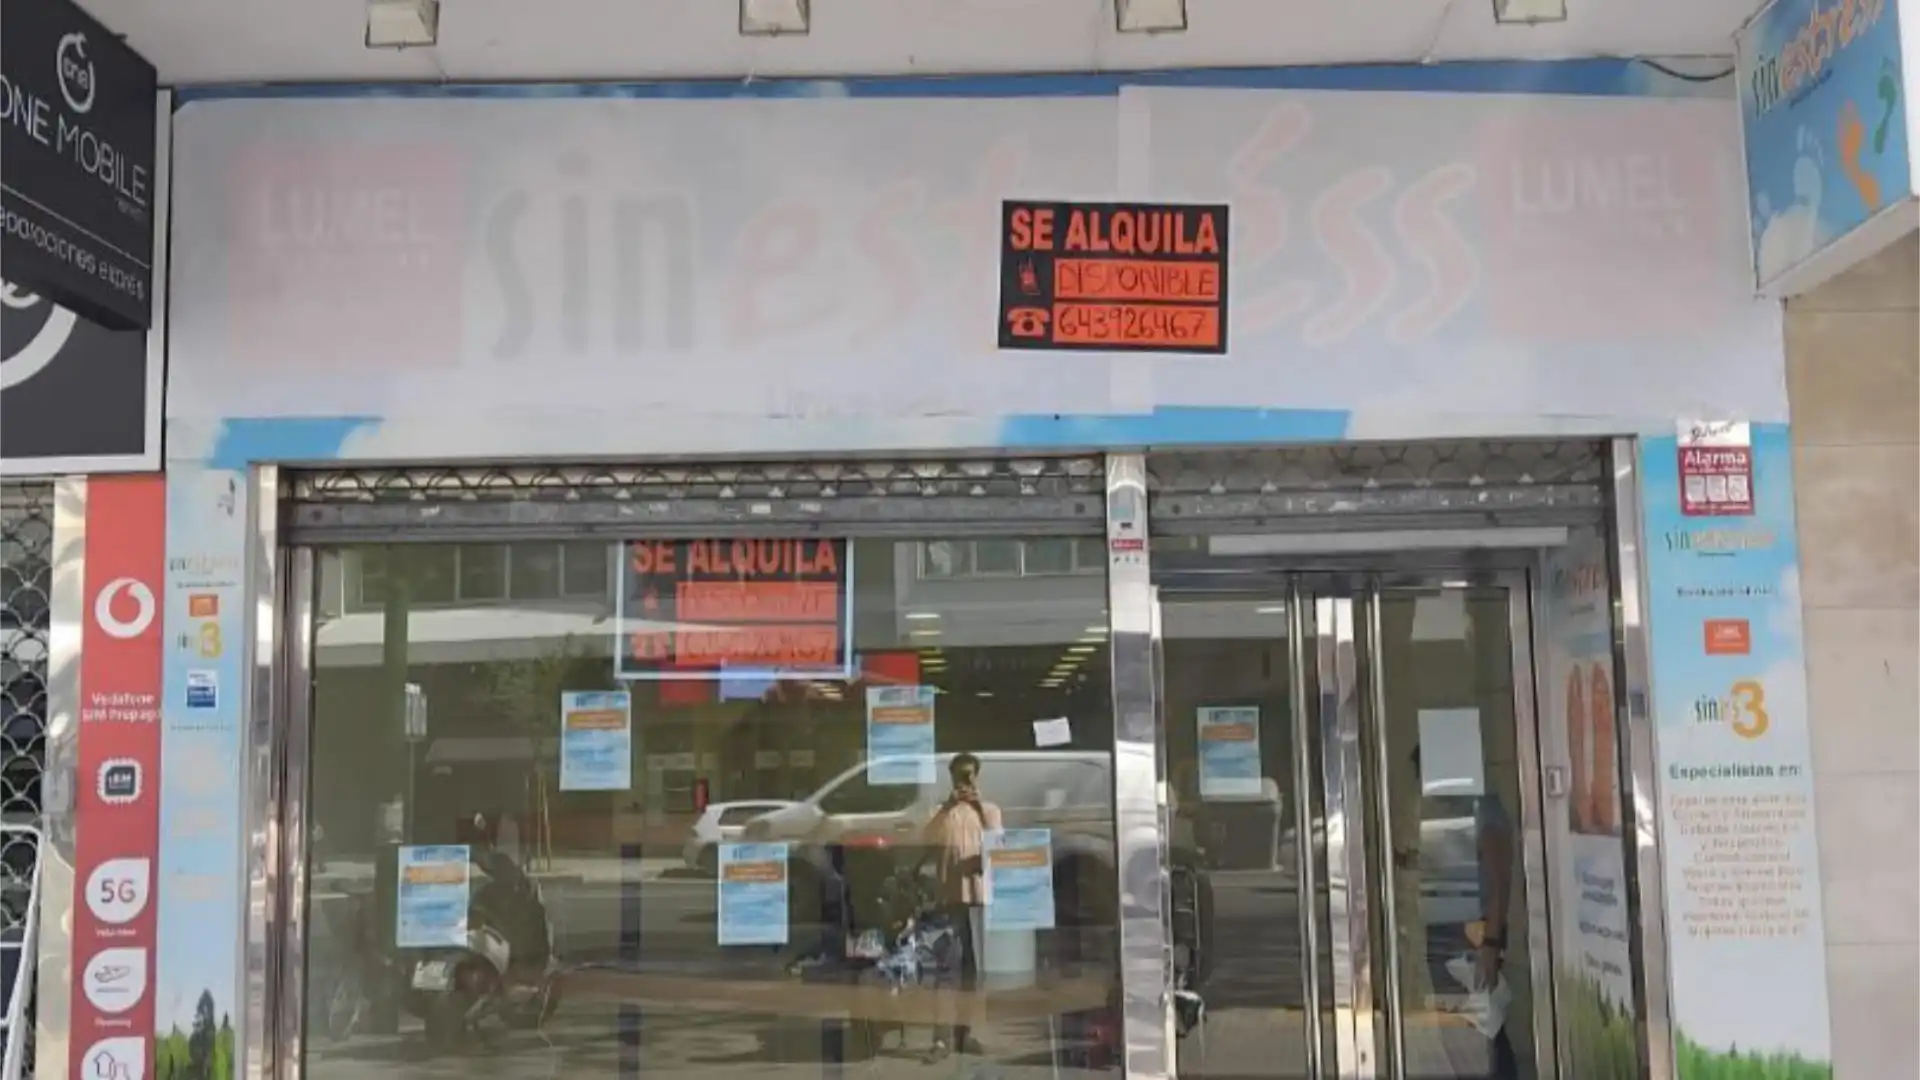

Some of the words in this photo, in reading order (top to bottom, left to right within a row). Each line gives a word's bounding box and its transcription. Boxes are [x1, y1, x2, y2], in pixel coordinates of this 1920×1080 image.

[56, 113, 147, 206] MOBILE
[1010, 208, 1054, 250] SE
[1064, 209, 1218, 254] ALQUILA
[1058, 261, 1215, 296] DISPONIBLE
[1058, 307, 1206, 338] 643926467
[1684, 451, 1746, 467] Alarma
[632, 538, 676, 573] SE
[686, 538, 837, 575] ALQUILA
[100, 879, 136, 904] 5G
